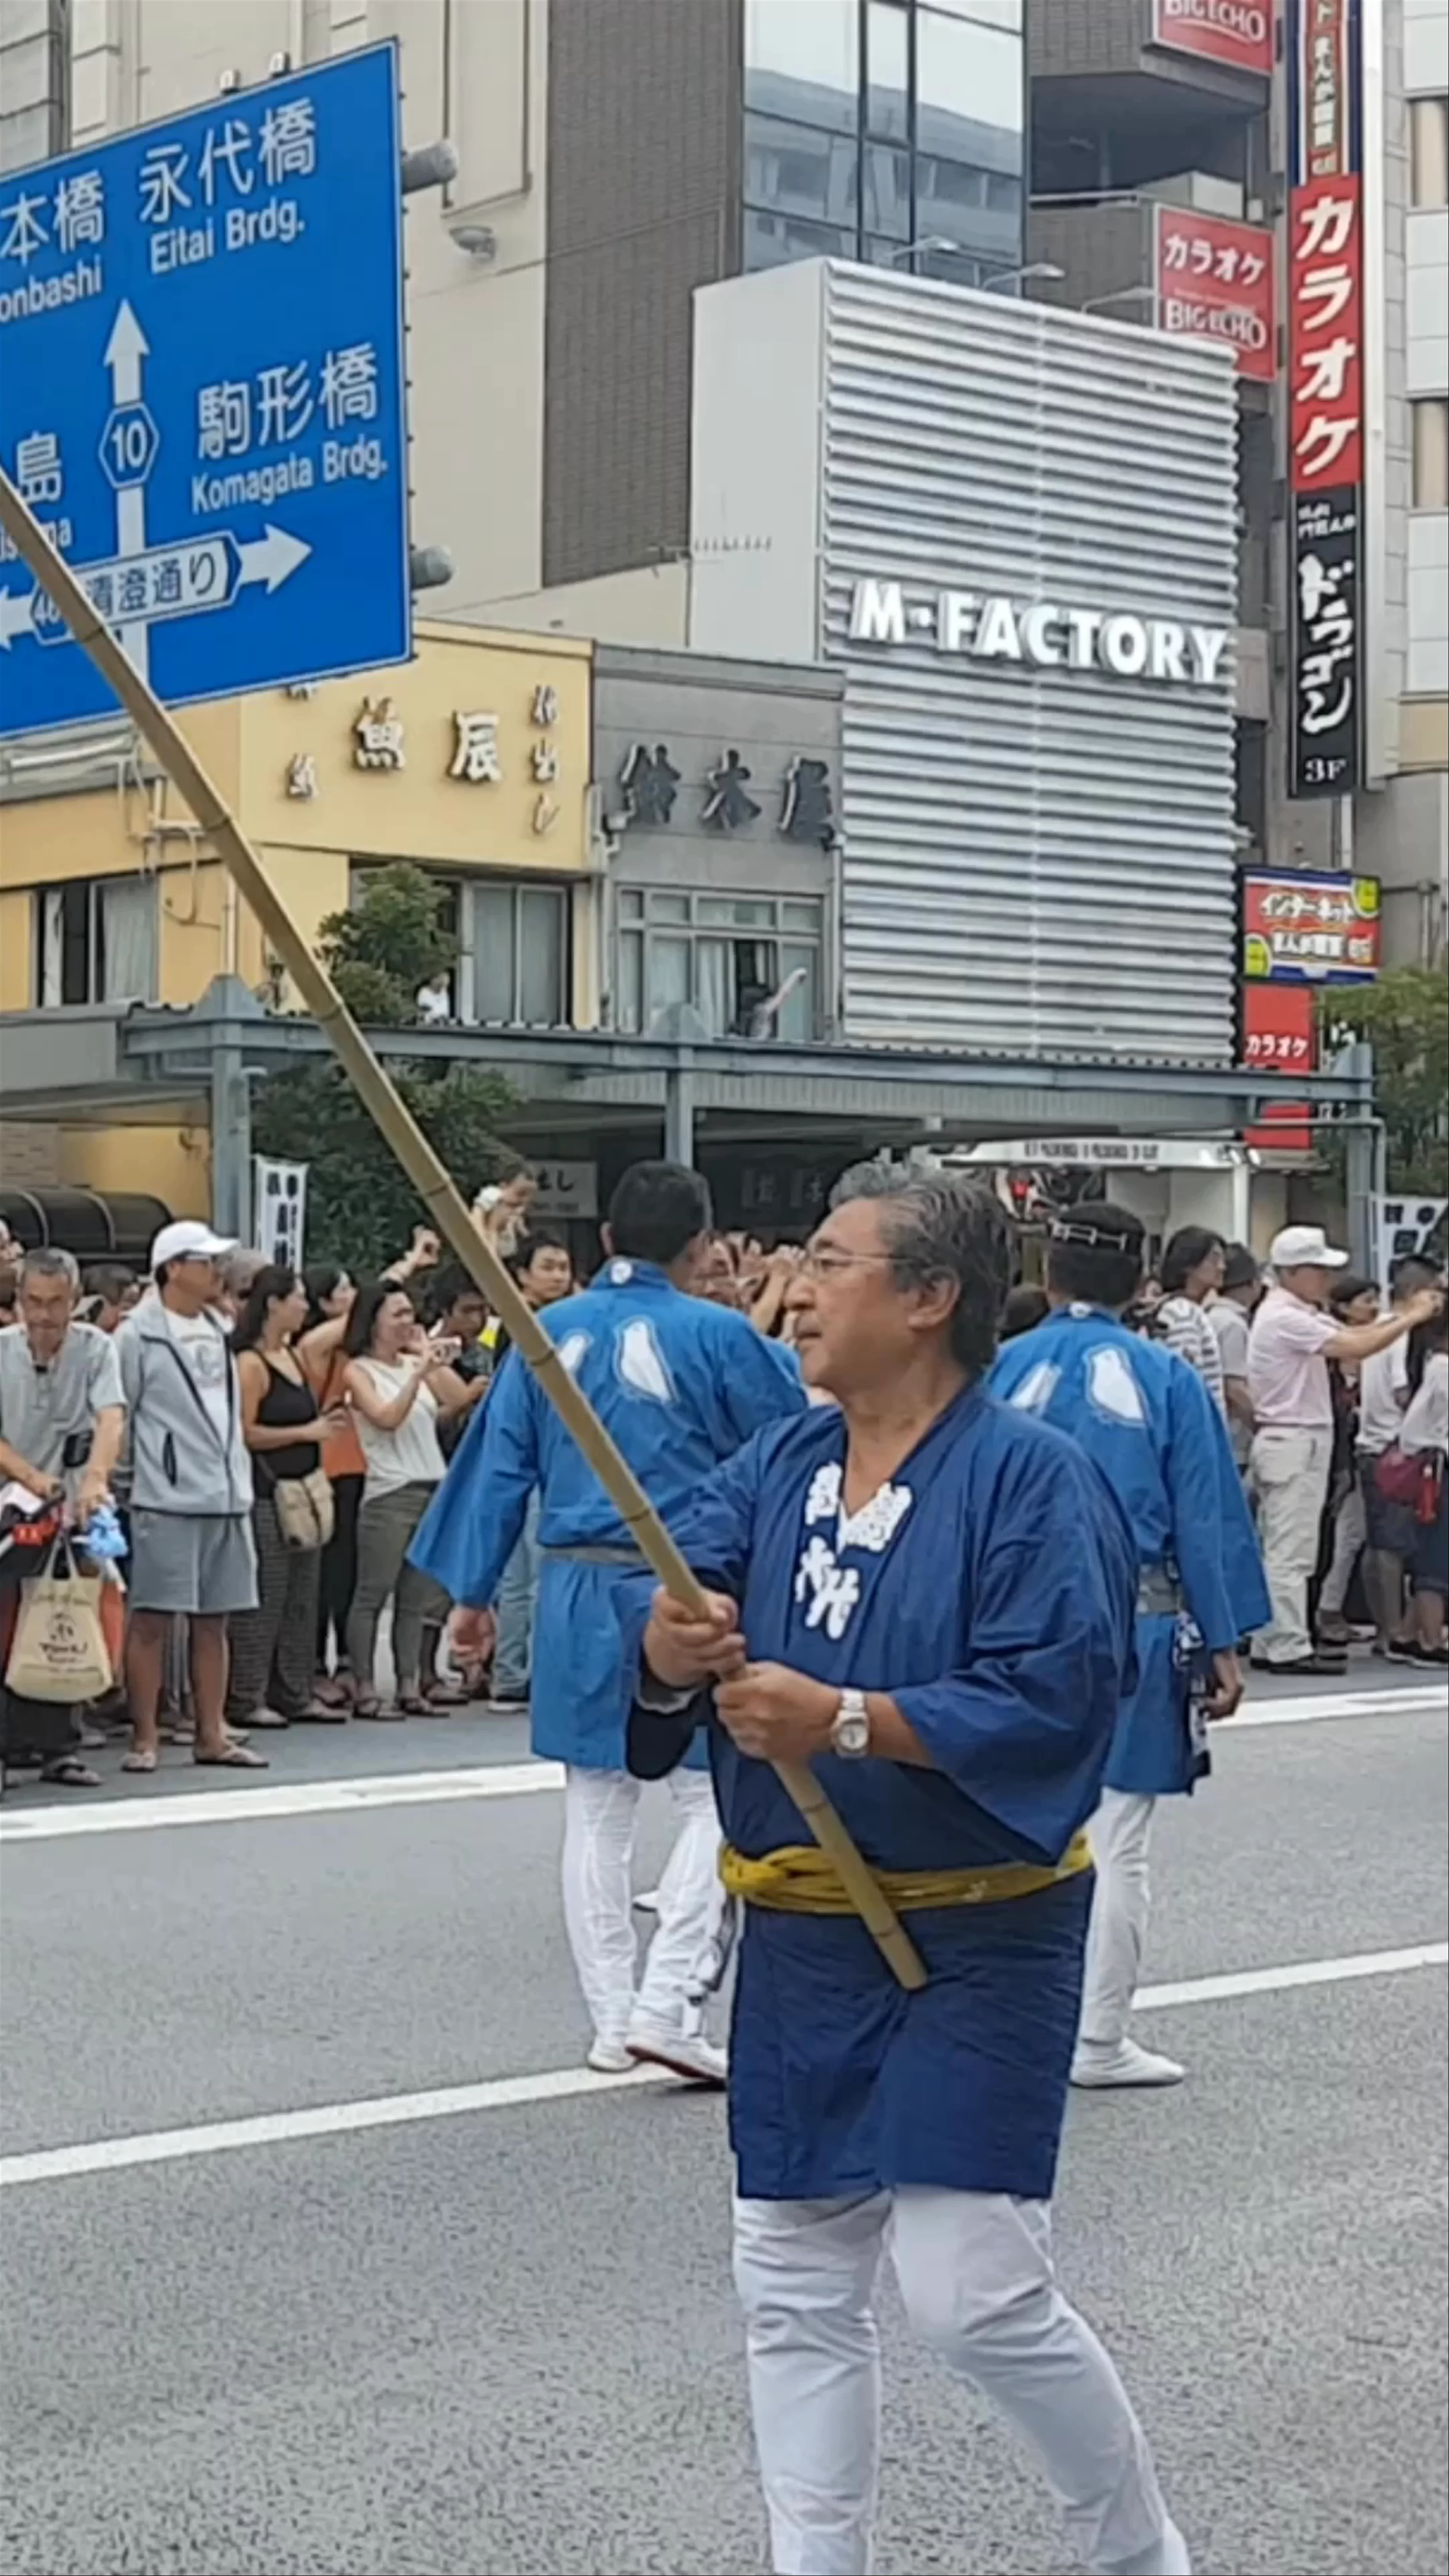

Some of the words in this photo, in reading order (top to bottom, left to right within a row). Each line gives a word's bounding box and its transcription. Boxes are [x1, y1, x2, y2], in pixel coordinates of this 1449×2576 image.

[139, 97, 316, 223] 永代橋
[0, 169, 104, 267] 本橋
[151, 218, 214, 275] Eitai
[226, 198, 305, 251] Brdg.
[1164, 233, 1266, 287] カラオケ
[1166, 297, 1206, 330] BIG
[1208, 308, 1267, 350] ECHO
[1295, 195, 1360, 476] カラオケ
[197, 343, 377, 460] 駒形橋
[17, 431, 62, 504] 島
[111, 420, 148, 472] 10
[191, 452, 314, 515] Komagata
[323, 438, 387, 482] Brdg.
[1298, 553, 1355, 734] ドラゴン
[1304, 757, 1347, 784] 3F
[1261, 893, 1353, 923] インターネット
[1245, 1034, 1309, 1058] カラオケ
